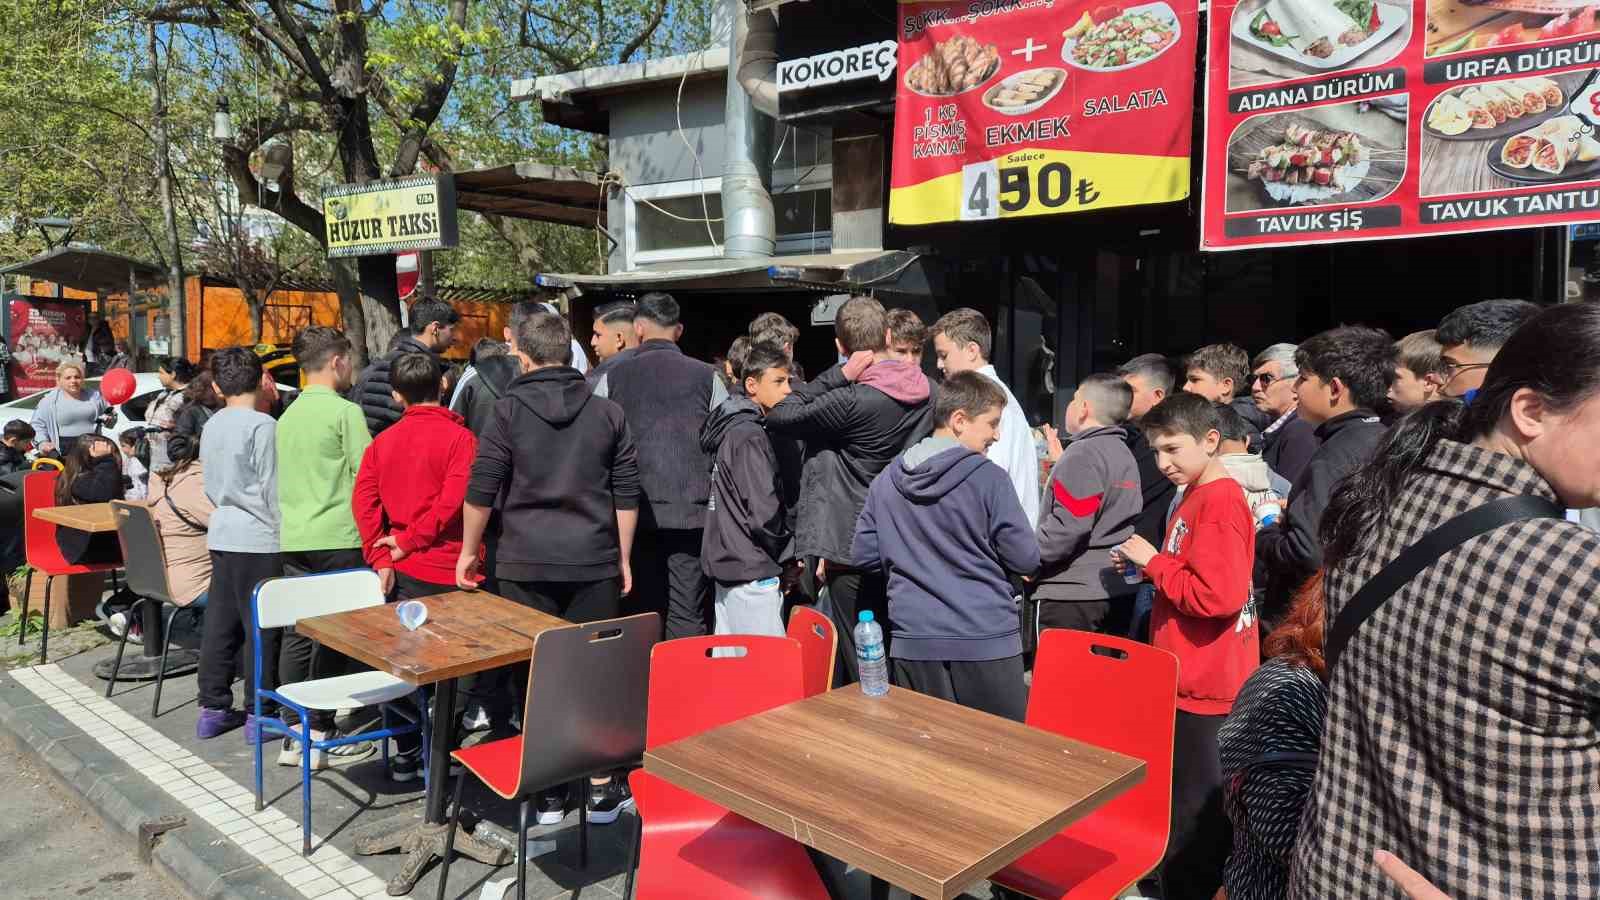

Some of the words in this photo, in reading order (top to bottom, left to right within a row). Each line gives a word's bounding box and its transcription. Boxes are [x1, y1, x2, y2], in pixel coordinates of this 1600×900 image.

[782, 46, 890, 85] KOKOREÇ
[1446, 56, 1511, 80] URFA
[1083, 88, 1167, 117] SALATA
[1238, 88, 1307, 112] ADANA
[1313, 73, 1395, 101] DÜRÜM
[924, 107, 932, 122] 1
[938, 103, 958, 121] KG
[986, 116, 1071, 147] EKMEK
[913, 139, 967, 159] KANAT
[1008, 152, 1046, 164] Sadece
[1256, 213, 1325, 232] TAVUK
[1328, 207, 1363, 232] ŞİŞ
[1428, 198, 1508, 220] TAVUK
[328, 218, 383, 243] HUZUR
